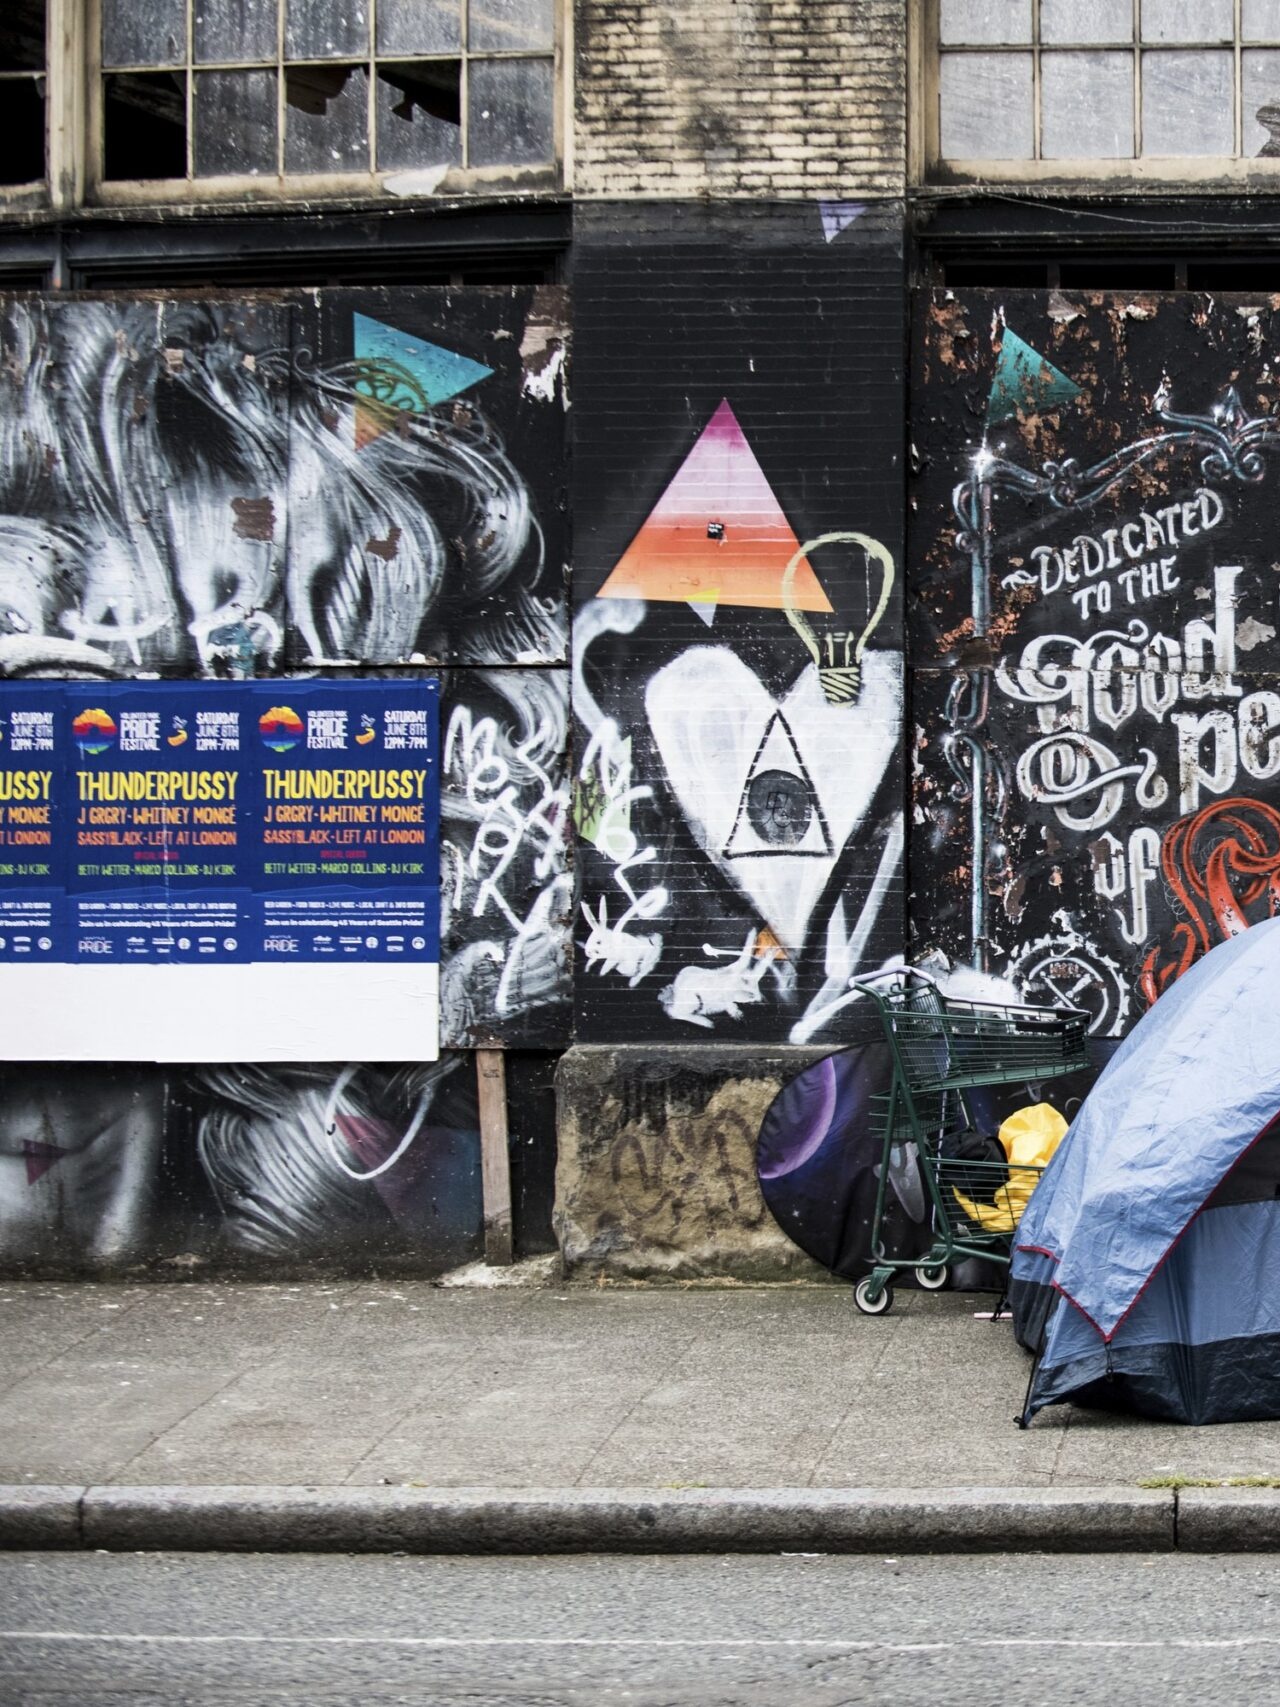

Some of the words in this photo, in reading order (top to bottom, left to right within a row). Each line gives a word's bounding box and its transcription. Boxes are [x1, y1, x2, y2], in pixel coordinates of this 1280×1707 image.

[1030, 487, 1224, 595] DEDICATED
[1072, 580, 1112, 620] TO
[1118, 555, 1181, 604] THE
[195, 712, 239, 725] SATURDAY
[384, 710, 427, 723] SATURDAY
[120, 719, 160, 738] PRIDE
[195, 724, 220, 738] JUNE
[307, 718, 348, 737] PRIDE
[384, 723, 408, 736] JUNE
[409, 723, 427, 736] 8TH
[120, 738, 160, 751] FESTIVAL
[307, 736, 348, 749] FESTIVAL
[76, 771, 239, 800] THUNDERPUSSY
[263, 769, 427, 799] THUNDERPUSSY
[7, 831, 52, 845] LONDON
[176, 831, 190, 846] AT
[192, 831, 237, 846] LONDON
[336, 829, 361, 844] LEFT
[364, 829, 377, 844] AT
[380, 829, 425, 844] LONDON
[264, 863, 286, 874] BETTY
[1095, 826, 1161, 945] of
[78, 941, 113, 953] PRIDE
[264, 939, 299, 952] PRIDE
